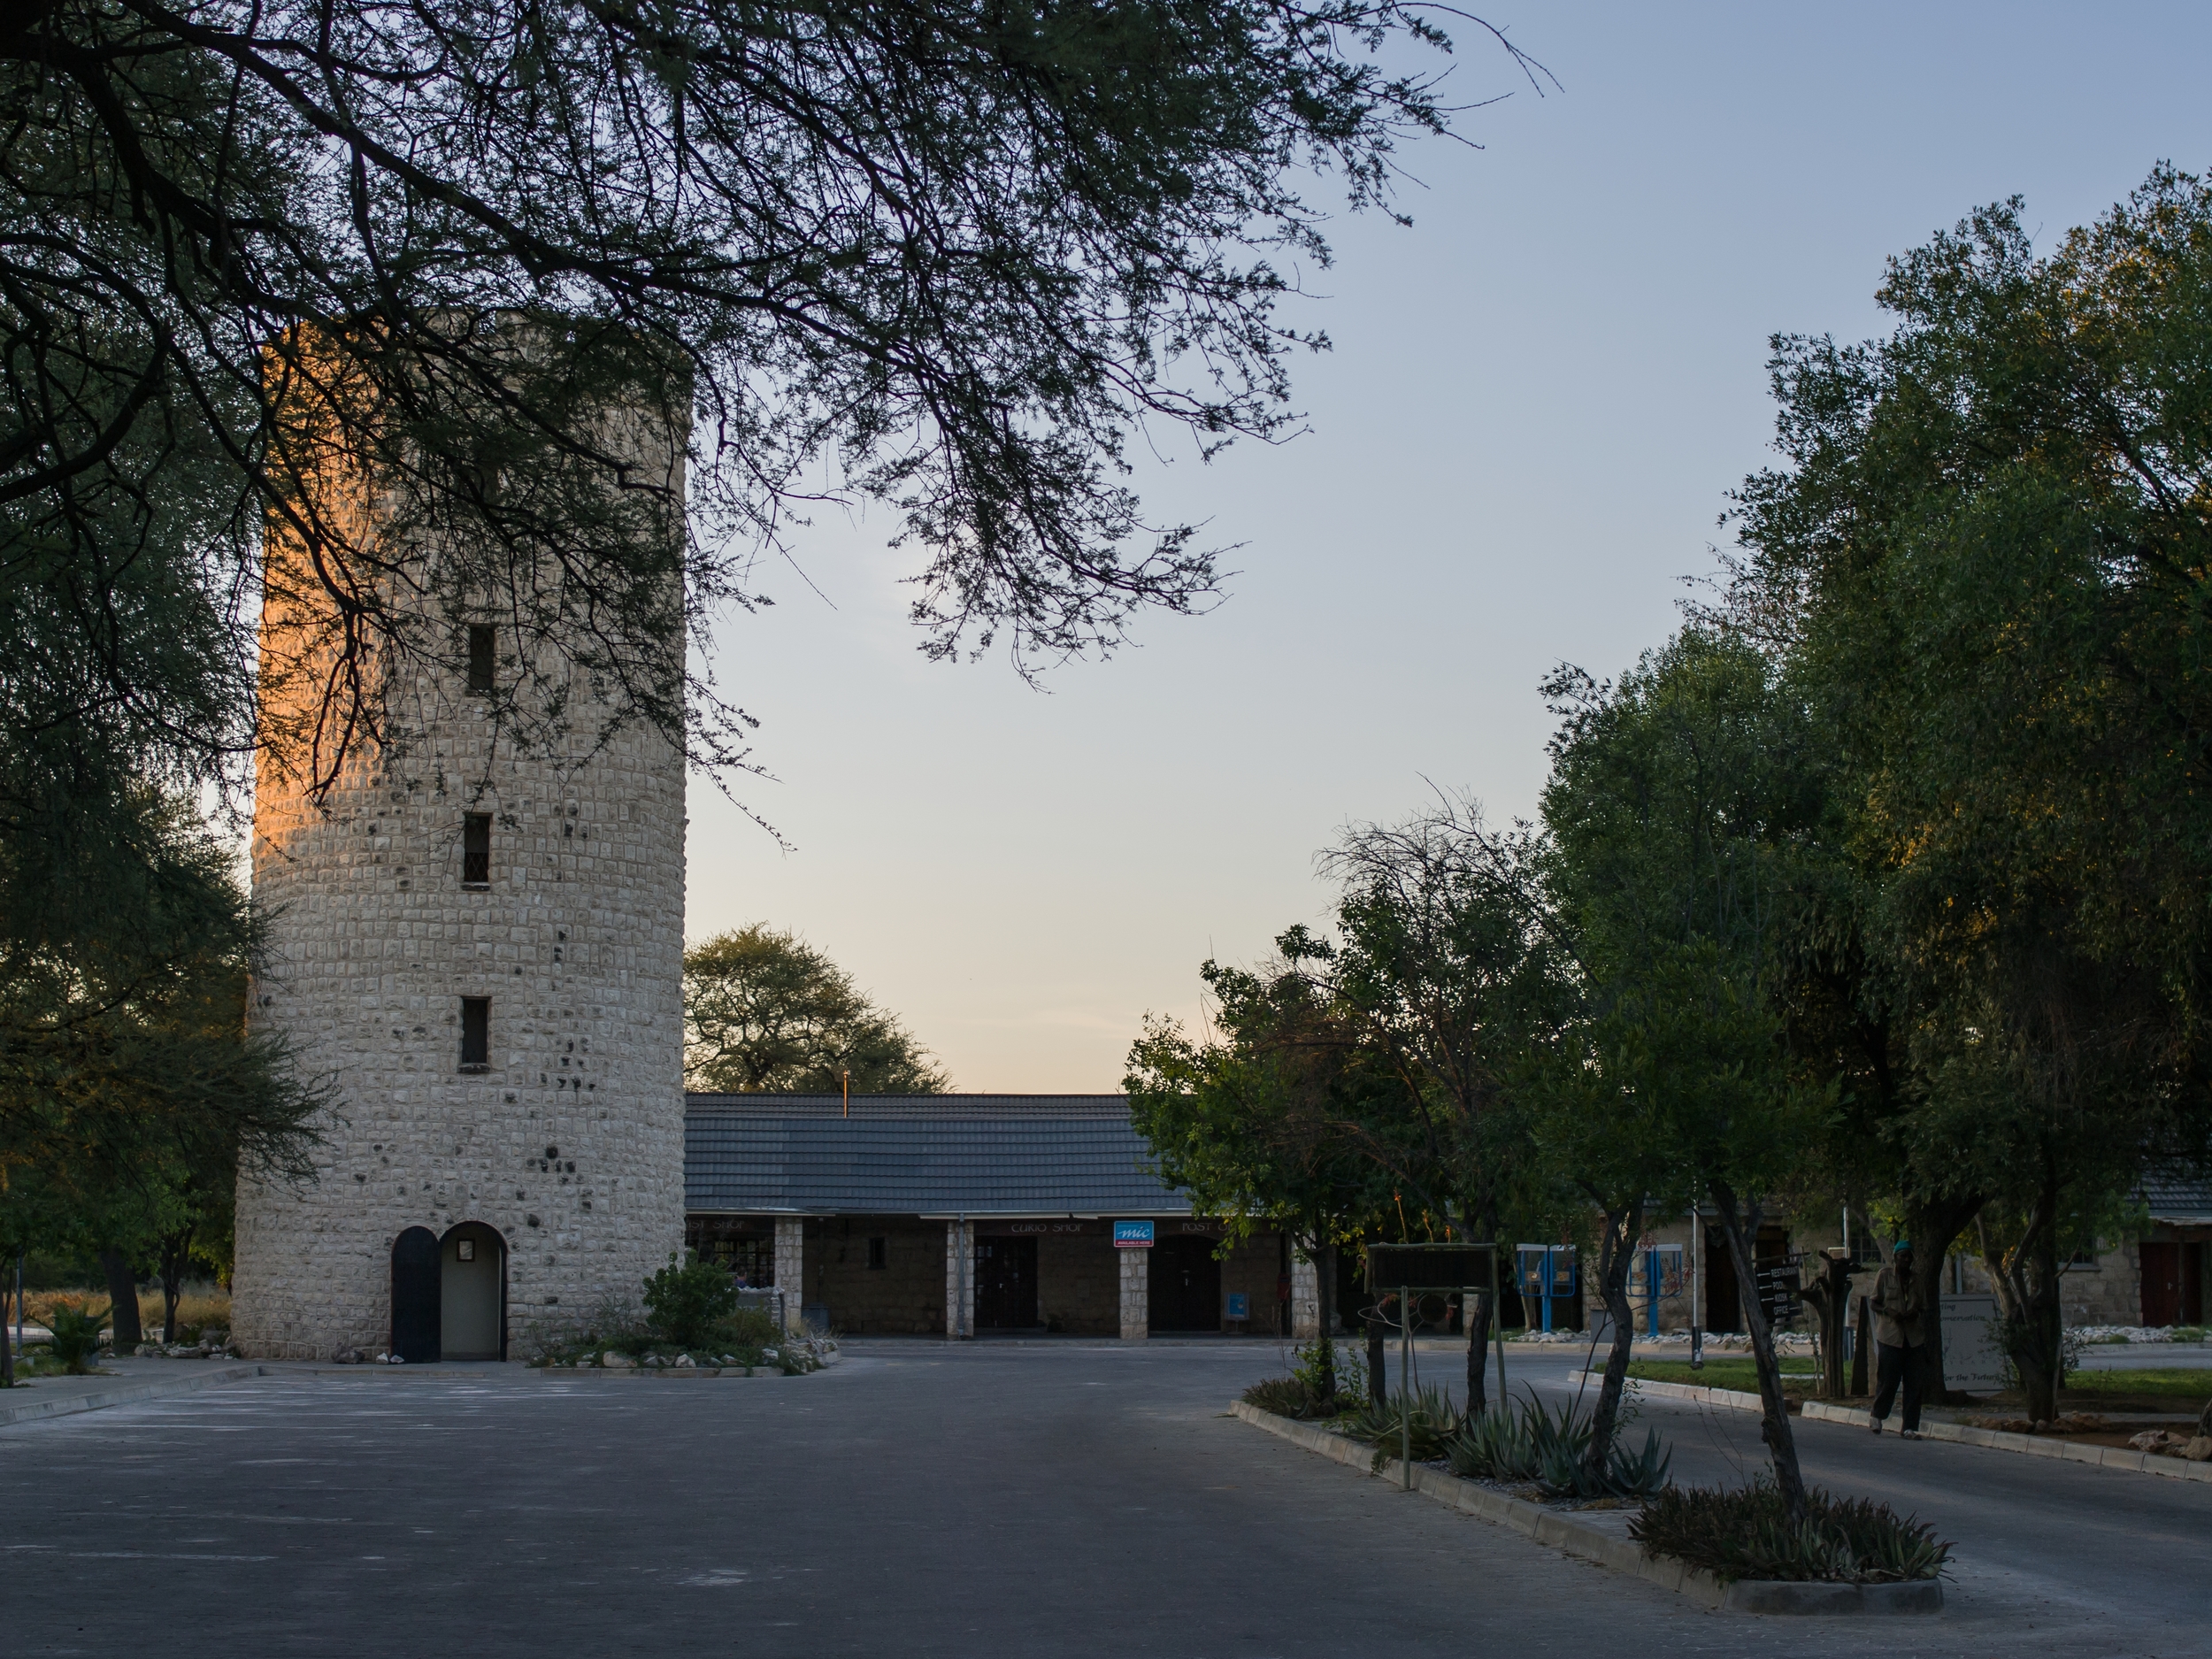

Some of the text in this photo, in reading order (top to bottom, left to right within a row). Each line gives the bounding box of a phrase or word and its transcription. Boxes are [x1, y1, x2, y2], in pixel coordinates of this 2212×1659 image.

[712, 1219, 745, 1229] SHOP
[1010, 1223, 1084, 1233] CURIO SHOP
[1182, 1222, 1212, 1232] POST
[1773, 1305, 1788, 1316] OFFICE
